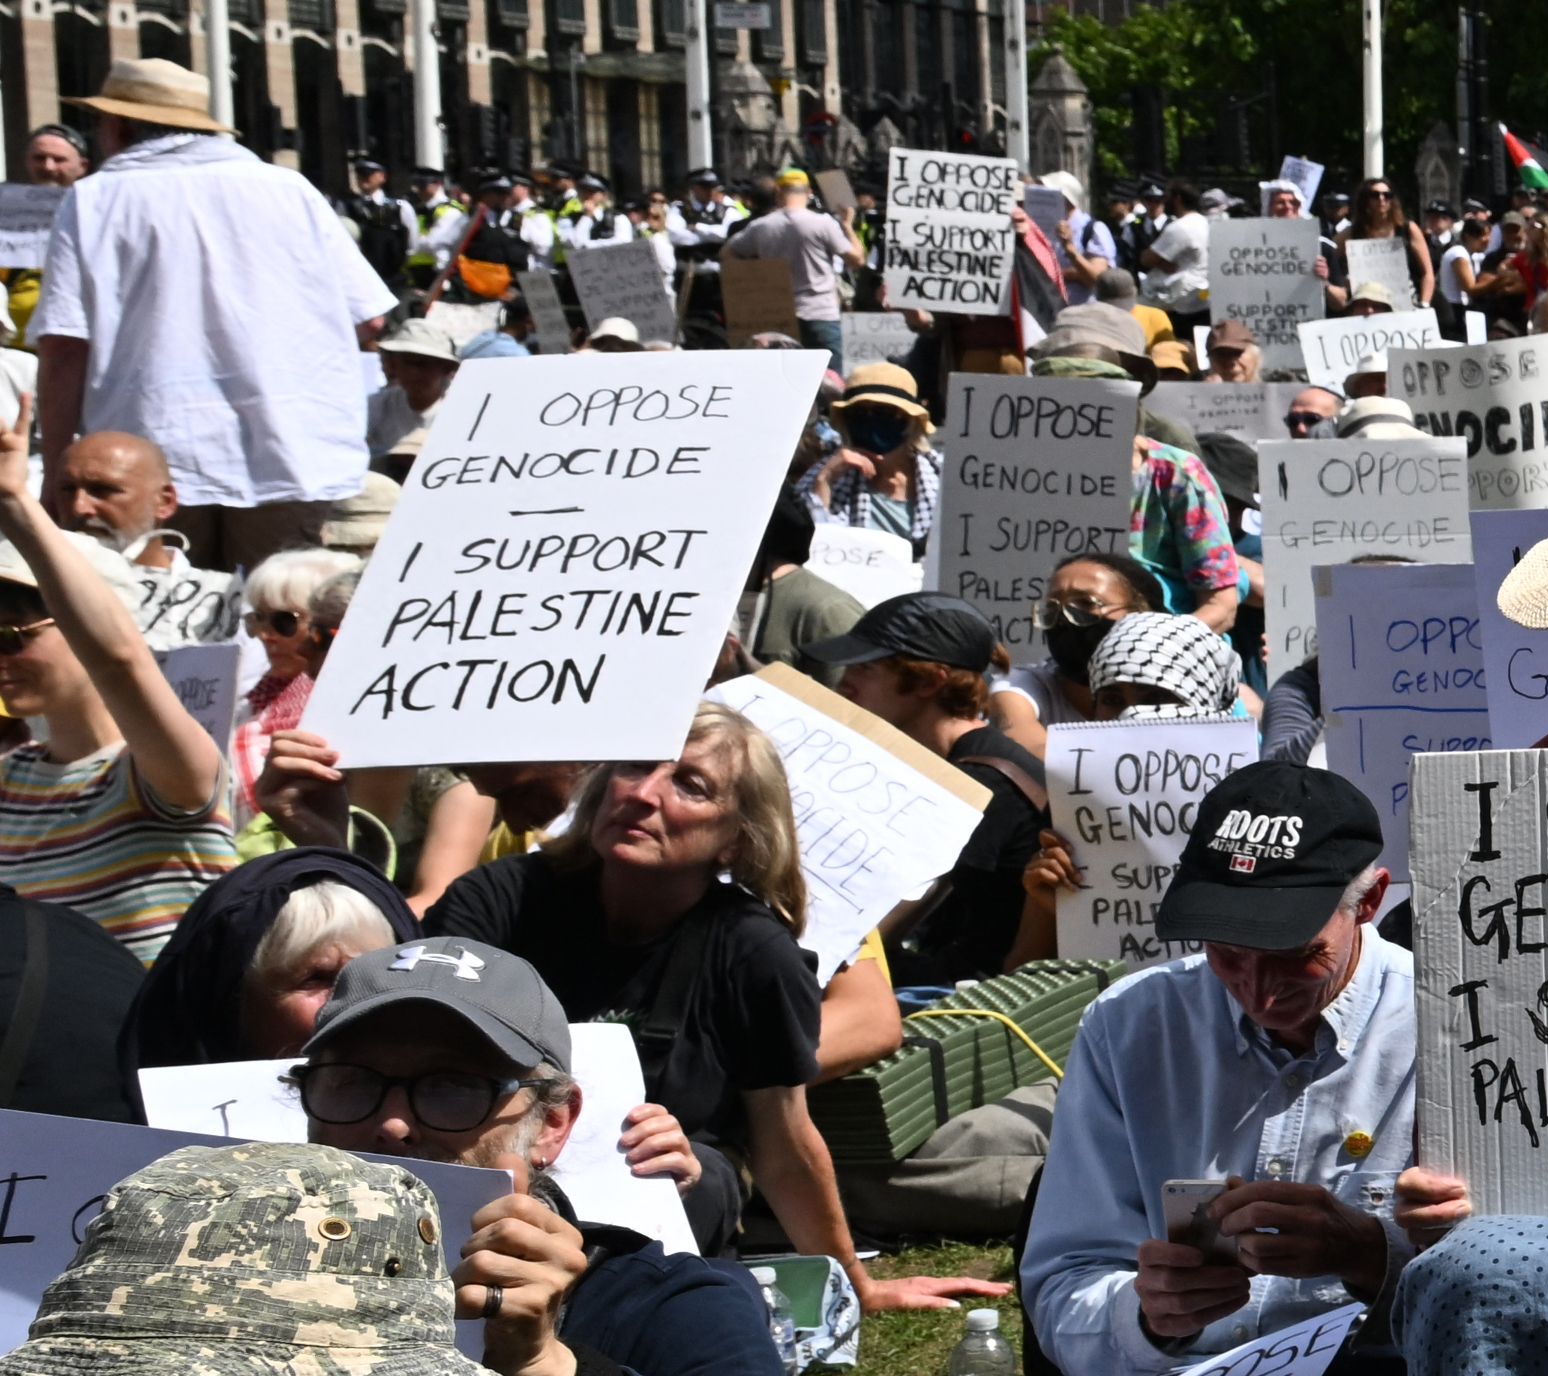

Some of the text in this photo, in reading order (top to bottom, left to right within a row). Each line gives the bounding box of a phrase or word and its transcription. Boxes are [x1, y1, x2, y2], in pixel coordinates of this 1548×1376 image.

[895, 156, 1014, 191] I OPPOSE
[893, 184, 1012, 215] GENOCIDE
[888, 219, 1011, 251] I SUPPORT
[1230, 246, 1298, 261] OPPOSE
[889, 246, 1003, 279] PALESTINE
[1221, 261, 1307, 276] GENOCIDE
[903, 276, 1000, 304] ACTION
[1227, 304, 1308, 319] SUPPORT
[1318, 336, 1331, 370] I
[1403, 349, 1538, 397] OPPOSE
[468, 385, 732, 441] I OPPOSE
[960, 387, 1113, 439] I OPPOSE
[422, 447, 710, 489] GENOCIDE
[960, 455, 1115, 496] GENOCIDE
[1278, 452, 1460, 500] I OPPOSE
[960, 514, 1126, 556] I SUPPORT
[1280, 517, 1454, 548] GENOCIDE
[399, 530, 707, 582] I SUPPORT
[382, 590, 699, 647] PALESTINE
[350, 654, 605, 719] ACTION
[769, 718, 937, 840] OPPOSE
[1068, 748, 1092, 795] I
[1216, 810, 1303, 847] ROOTS
[1464, 782, 1501, 863] I
[1208, 838, 1296, 860] ATHLETICS
[1448, 980, 1489, 1052] I
